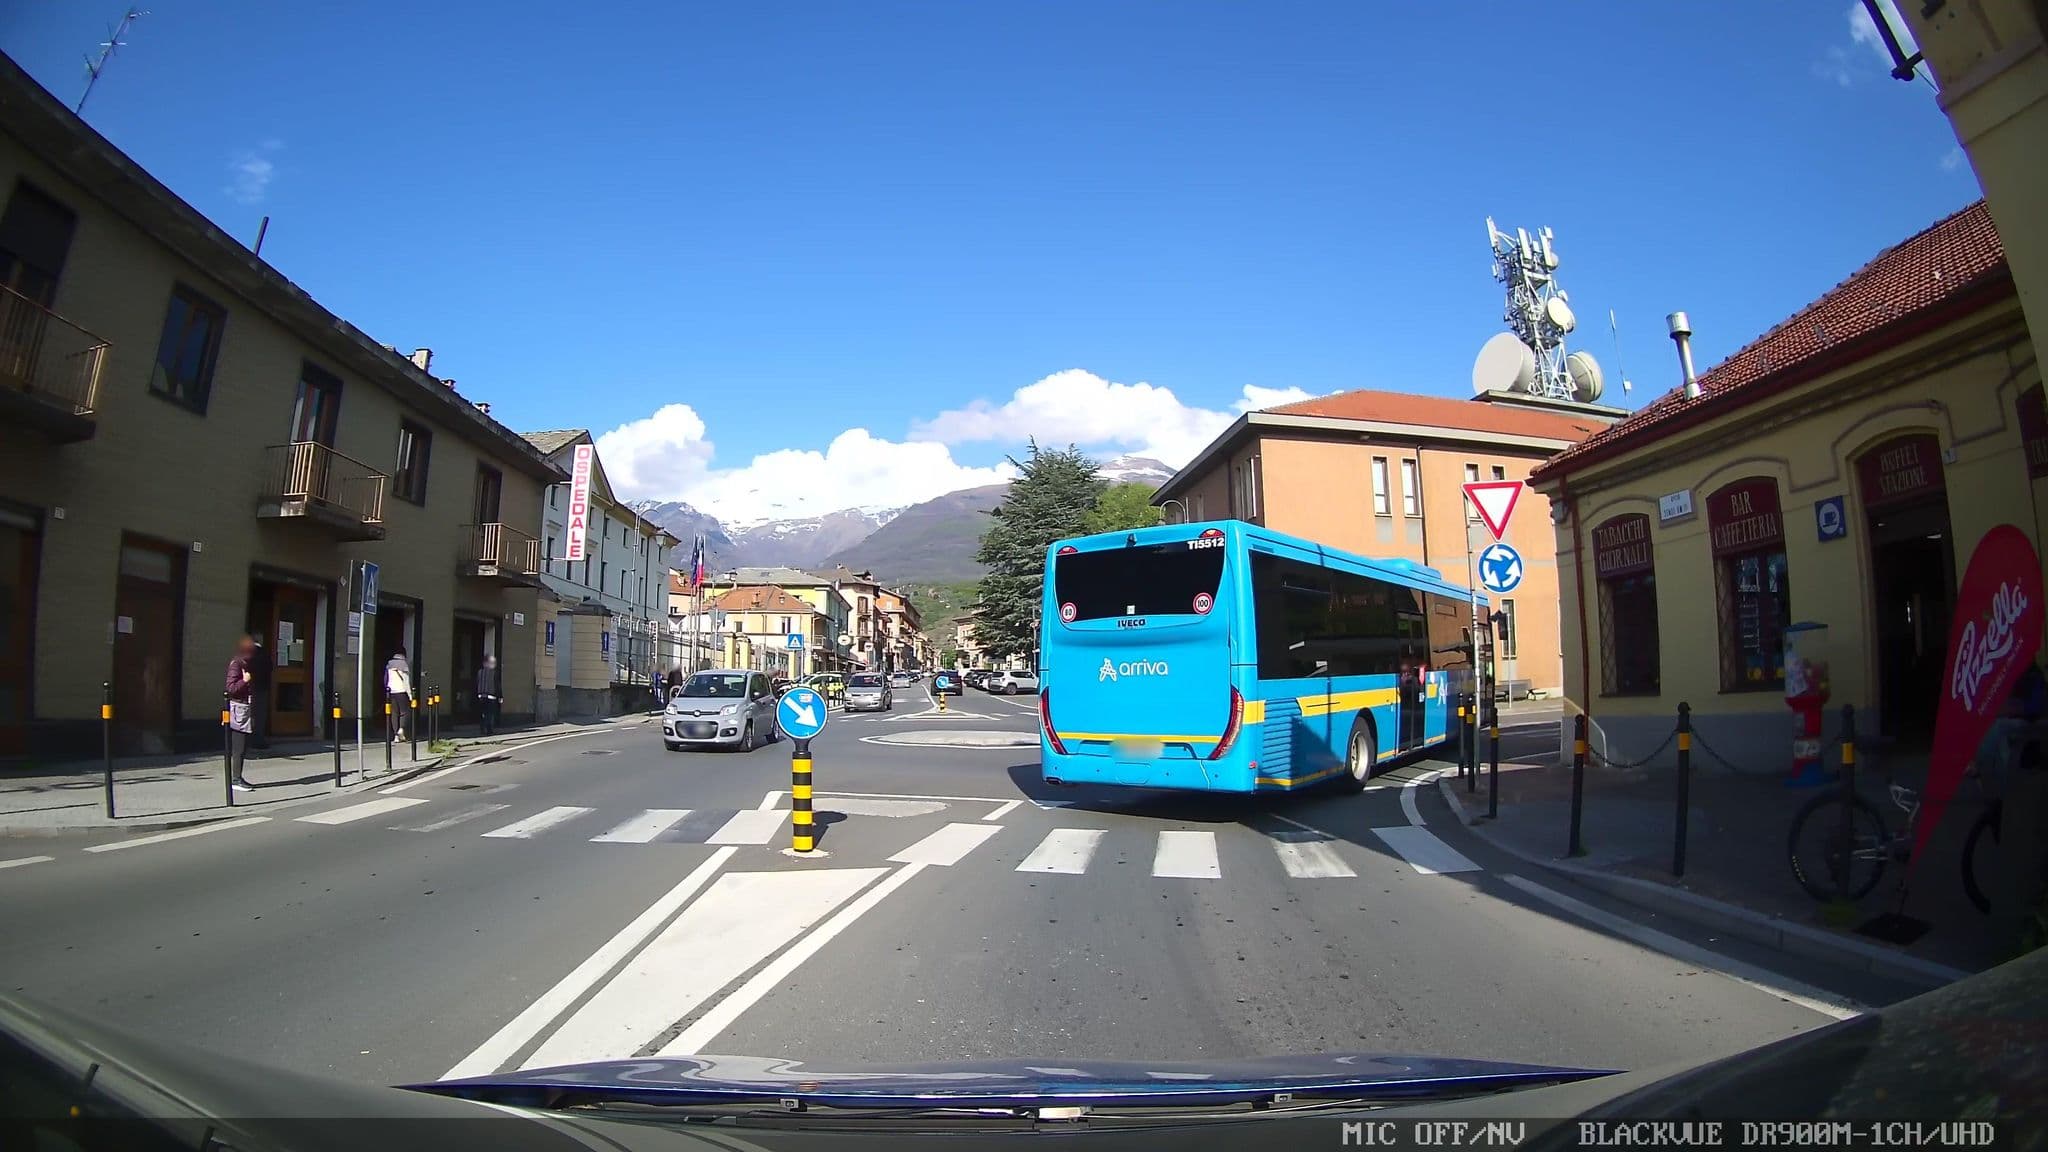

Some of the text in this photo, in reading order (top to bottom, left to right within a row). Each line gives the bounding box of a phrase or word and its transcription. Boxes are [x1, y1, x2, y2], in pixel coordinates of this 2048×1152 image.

[1880, 465, 1929, 496] STAZIONE
[569, 447, 590, 558] OSPEDALE
[1731, 491, 1753, 517] BAR
[1187, 538, 1225, 550] TI5512
[1598, 518, 1645, 547] TABACCHI
[1714, 513, 1777, 549] CAFFETTERIA
[1599, 542, 1648, 572] GIORNALI
[1197, 598, 1209, 608] 100
[1117, 619, 1146, 628] IVECO
[1118, 658, 1169, 676] arriva
